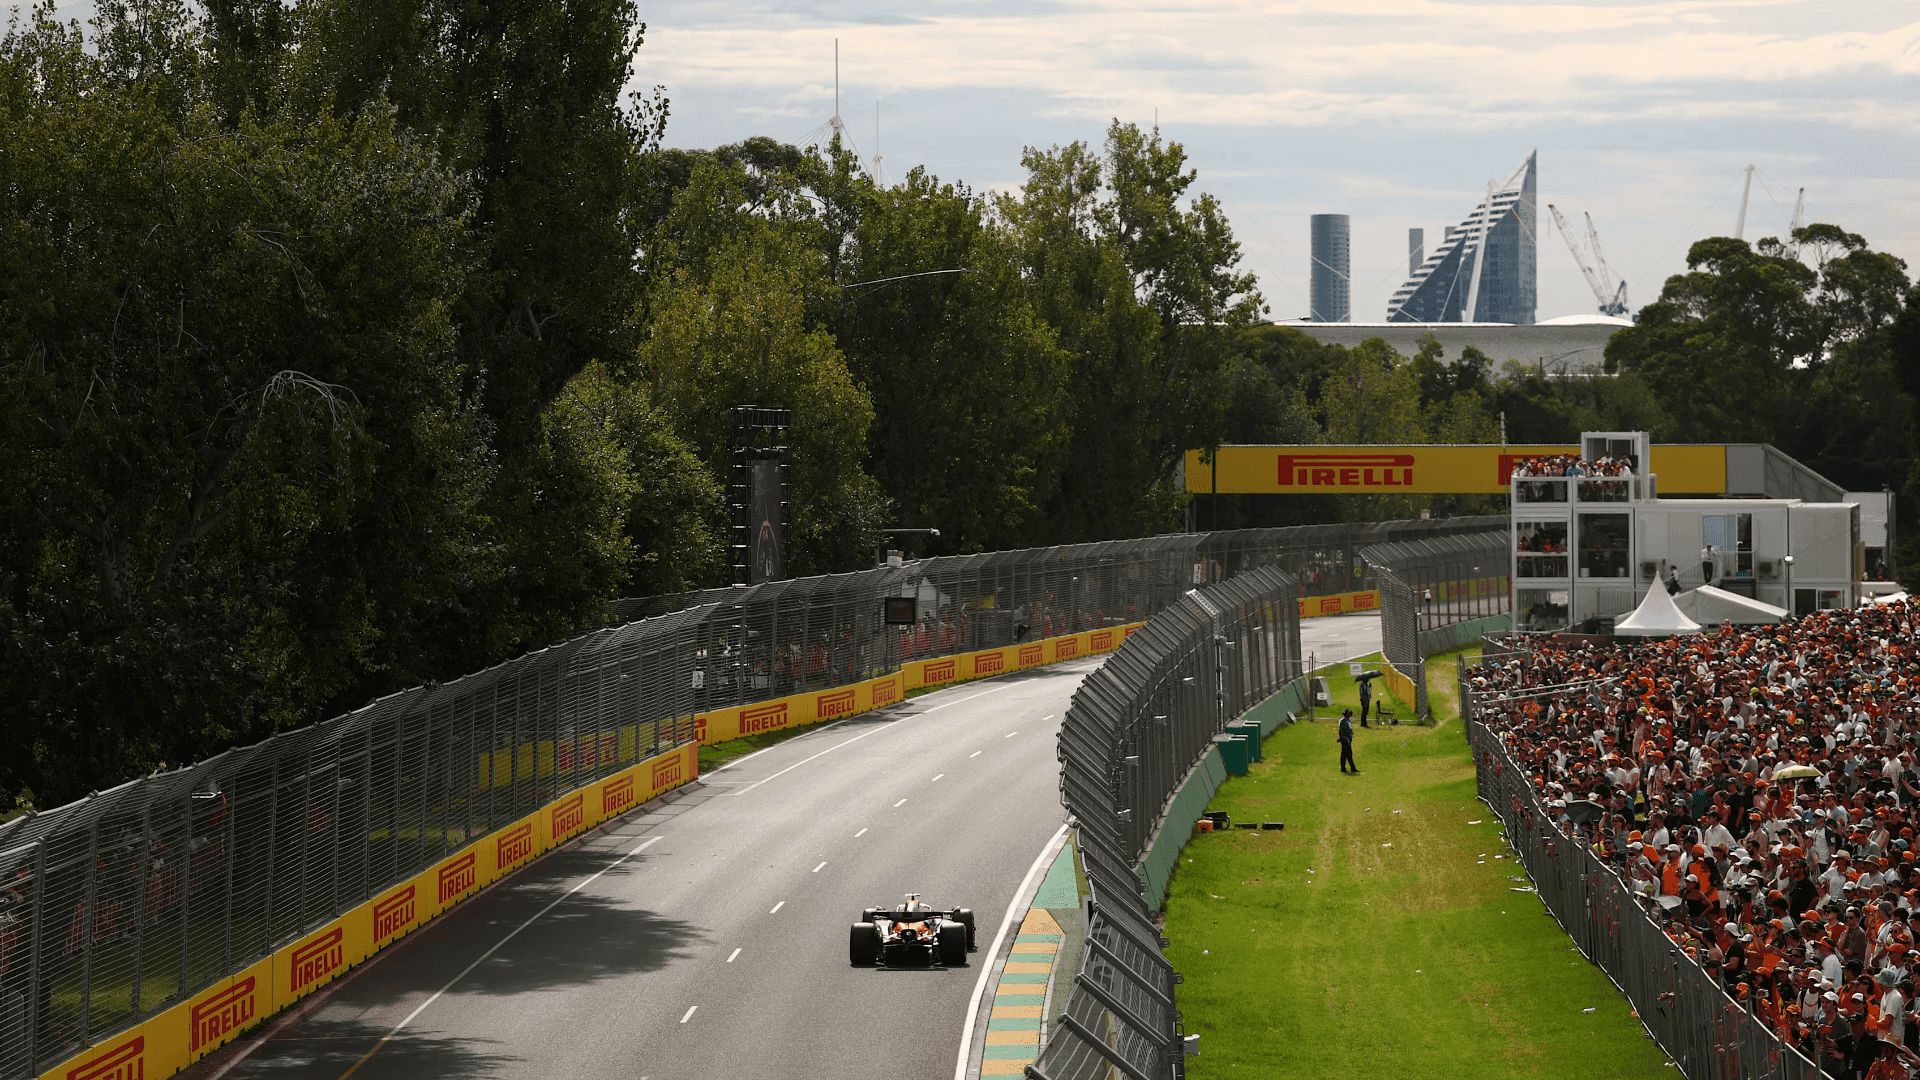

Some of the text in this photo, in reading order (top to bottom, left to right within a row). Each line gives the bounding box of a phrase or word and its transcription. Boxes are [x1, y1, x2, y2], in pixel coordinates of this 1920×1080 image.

[1278, 455, 1415, 486] PIRELLI
[1019, 645, 1043, 666] PIRELLI
[1056, 638, 1078, 659] PIRELLI
[1091, 631, 1112, 651] PIRELLI
[924, 660, 955, 684] PIRELLI
[975, 652, 1004, 674] PIRELLI
[817, 690, 855, 718] PIRELLI
[872, 679, 896, 705] PIRELLI
[739, 702, 788, 735] PIRELLI
[652, 753, 681, 791] PIRELLI
[603, 774, 634, 815] PIRELLI
[552, 794, 583, 840] PIRELLI
[497, 822, 532, 871] PIRELLI
[438, 851, 476, 905] PIRELLI
[373, 884, 416, 944] PIRELLI
[291, 926, 343, 994] PIRELLI
[191, 975, 256, 1053] PIRELLI
